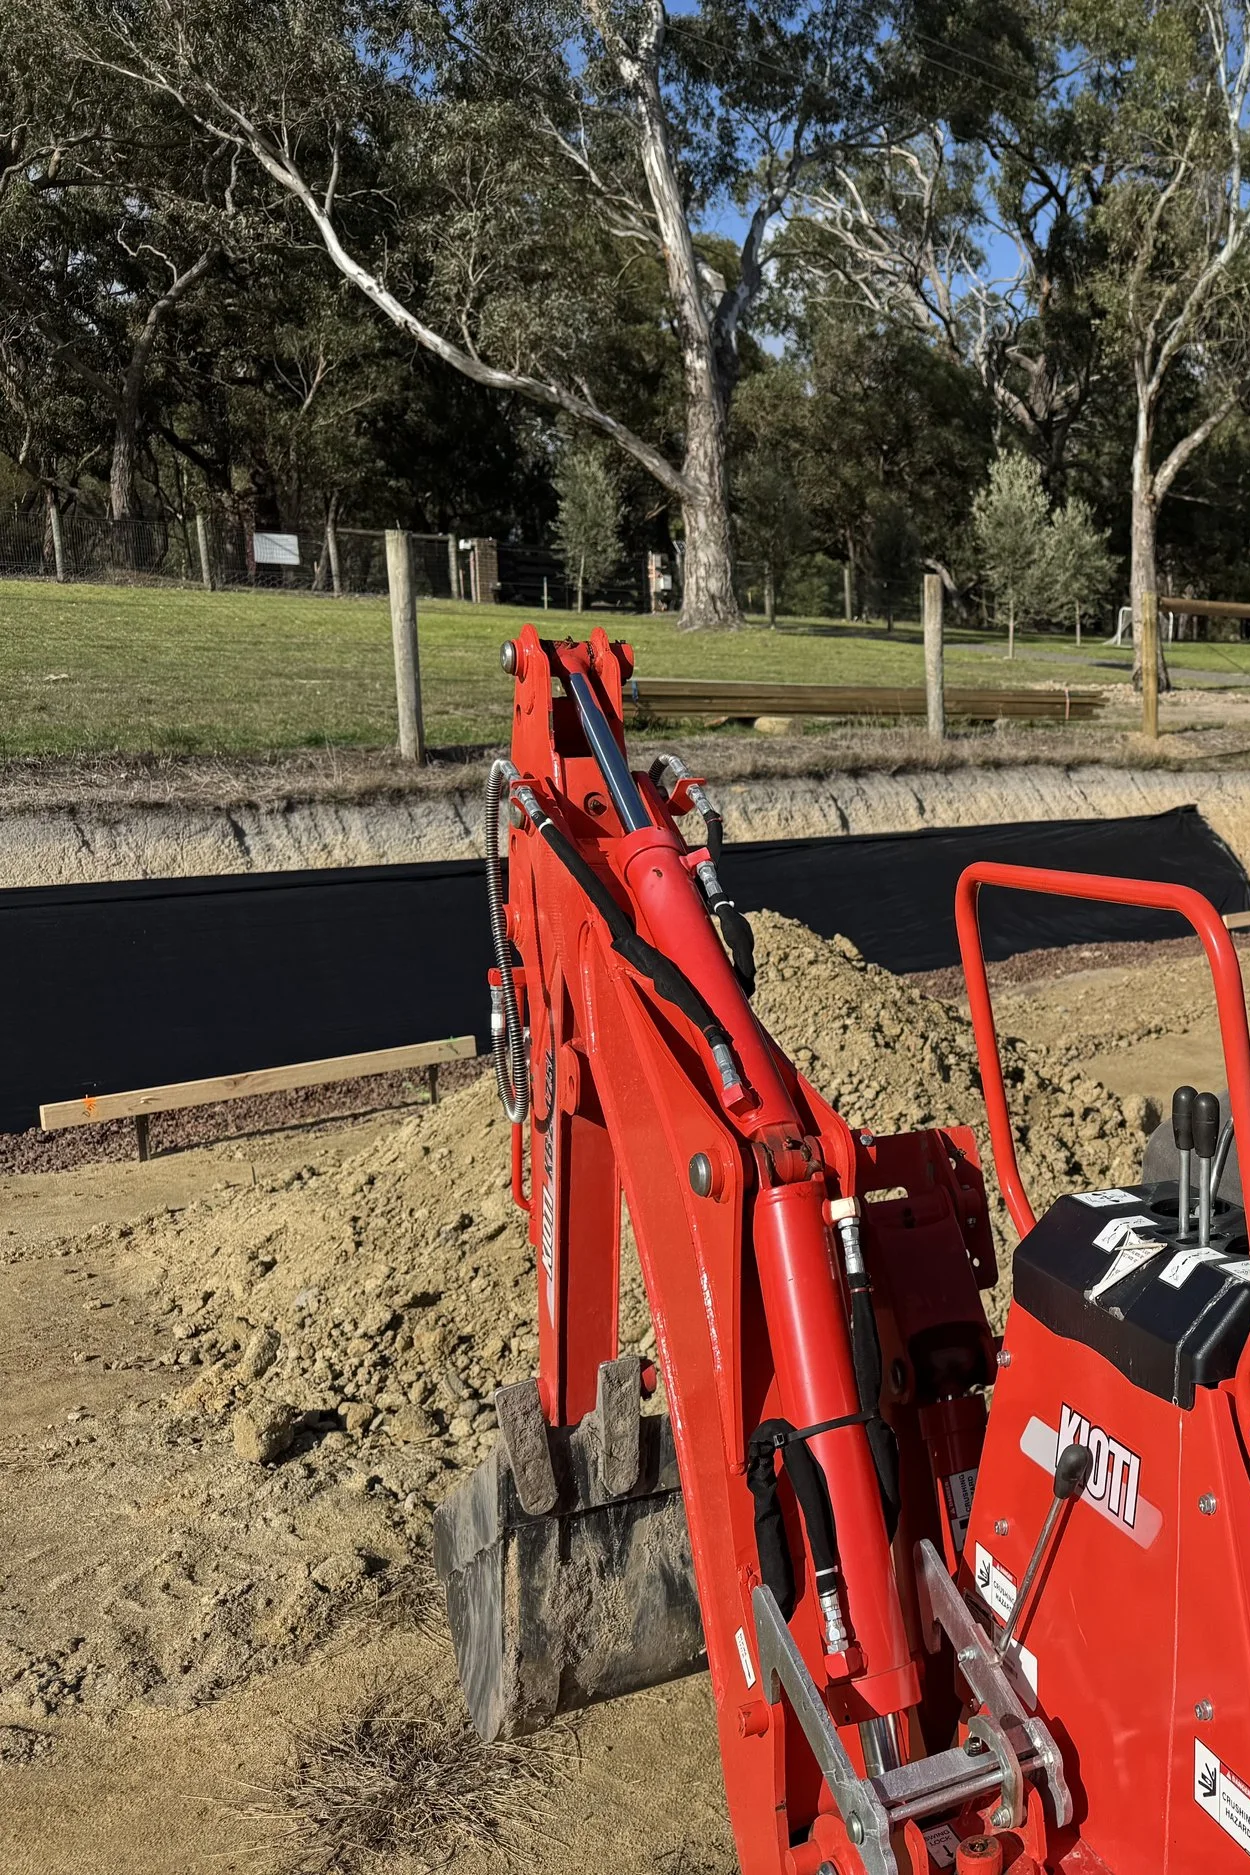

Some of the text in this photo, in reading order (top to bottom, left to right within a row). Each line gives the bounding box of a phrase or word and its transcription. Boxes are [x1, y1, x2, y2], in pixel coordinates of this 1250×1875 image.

[542, 1184, 553, 1282] KIOTI
[925, 1829, 950, 1841] SWING
[929, 1835, 952, 1846] LOCK
